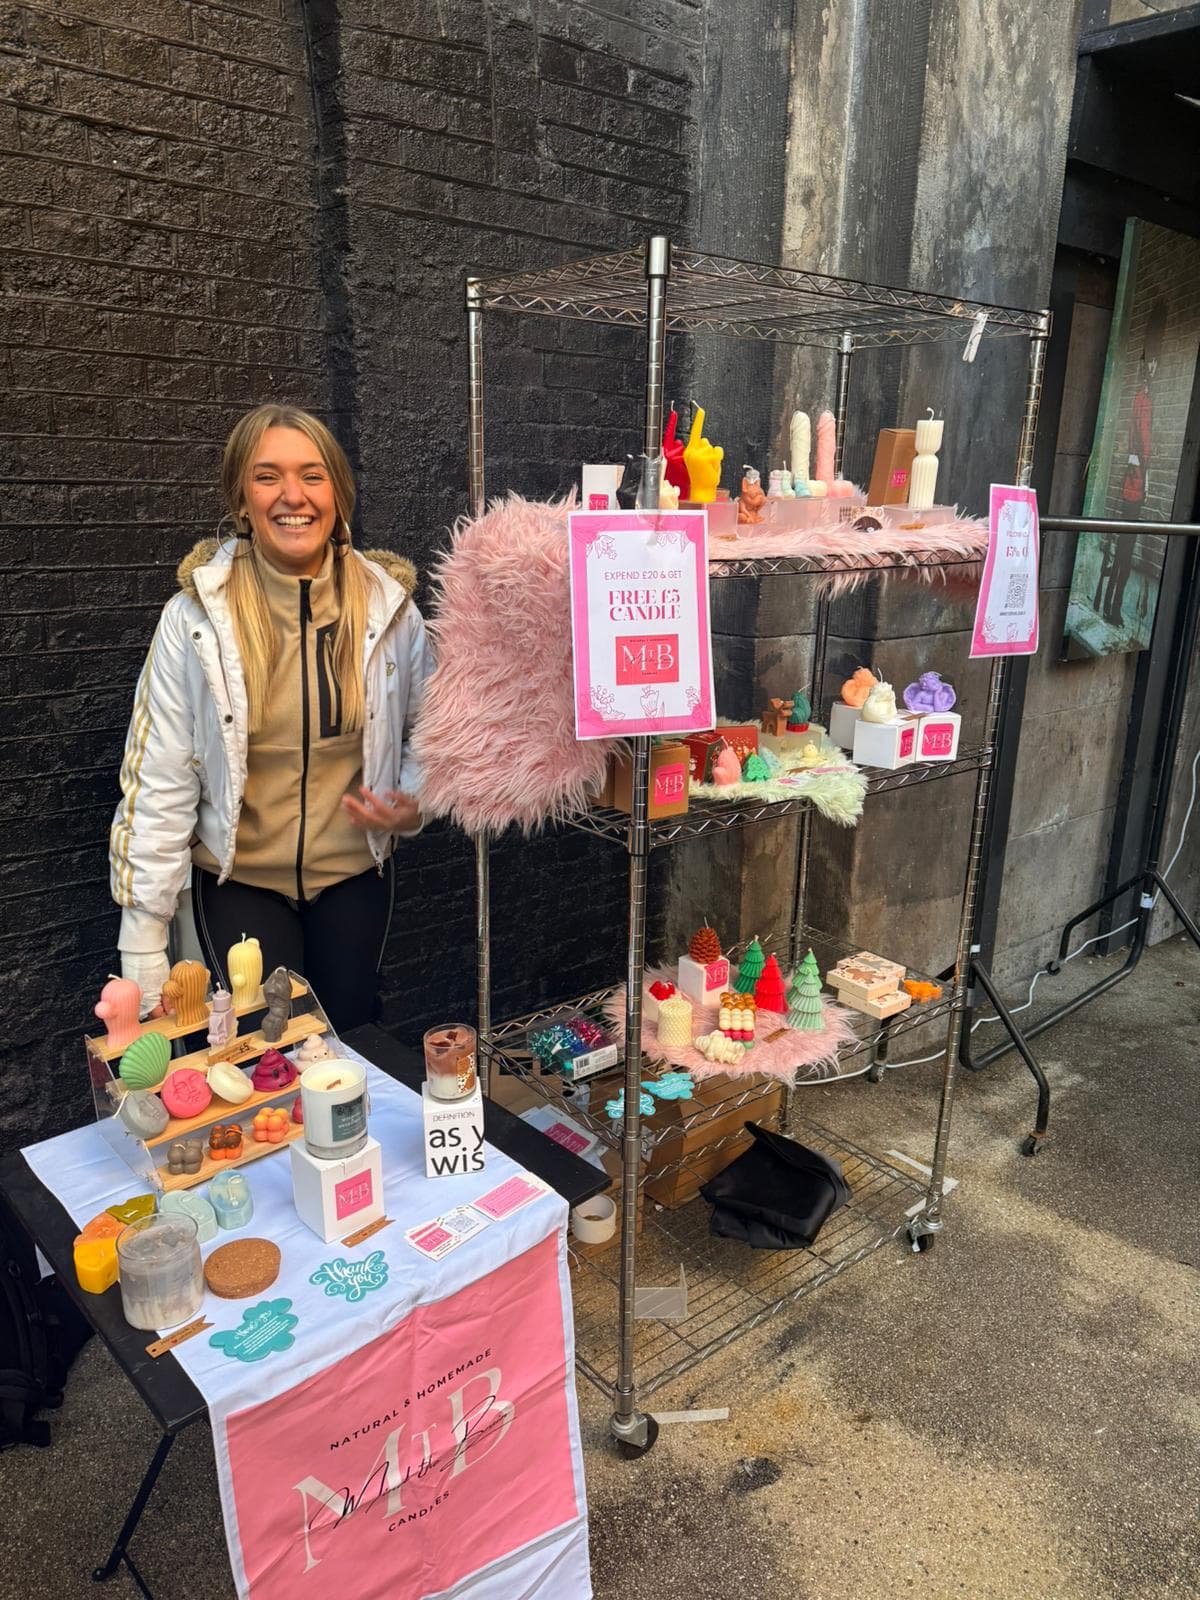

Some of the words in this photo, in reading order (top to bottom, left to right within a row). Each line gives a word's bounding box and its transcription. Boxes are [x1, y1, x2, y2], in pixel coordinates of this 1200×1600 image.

[604, 571, 640, 581] EXPEND
[642, 570, 658, 580] £20
[668, 570, 682, 579] GET
[609, 589, 657, 605] FREE
[662, 588, 681, 604] £5
[609, 604, 682, 622] CANDLE
[429, 1127, 461, 1148] as
[330, 1409, 399, 1450] NATURAL
[403, 1398, 411, 1408] &
[416, 1348, 492, 1400] HOMEMADE
